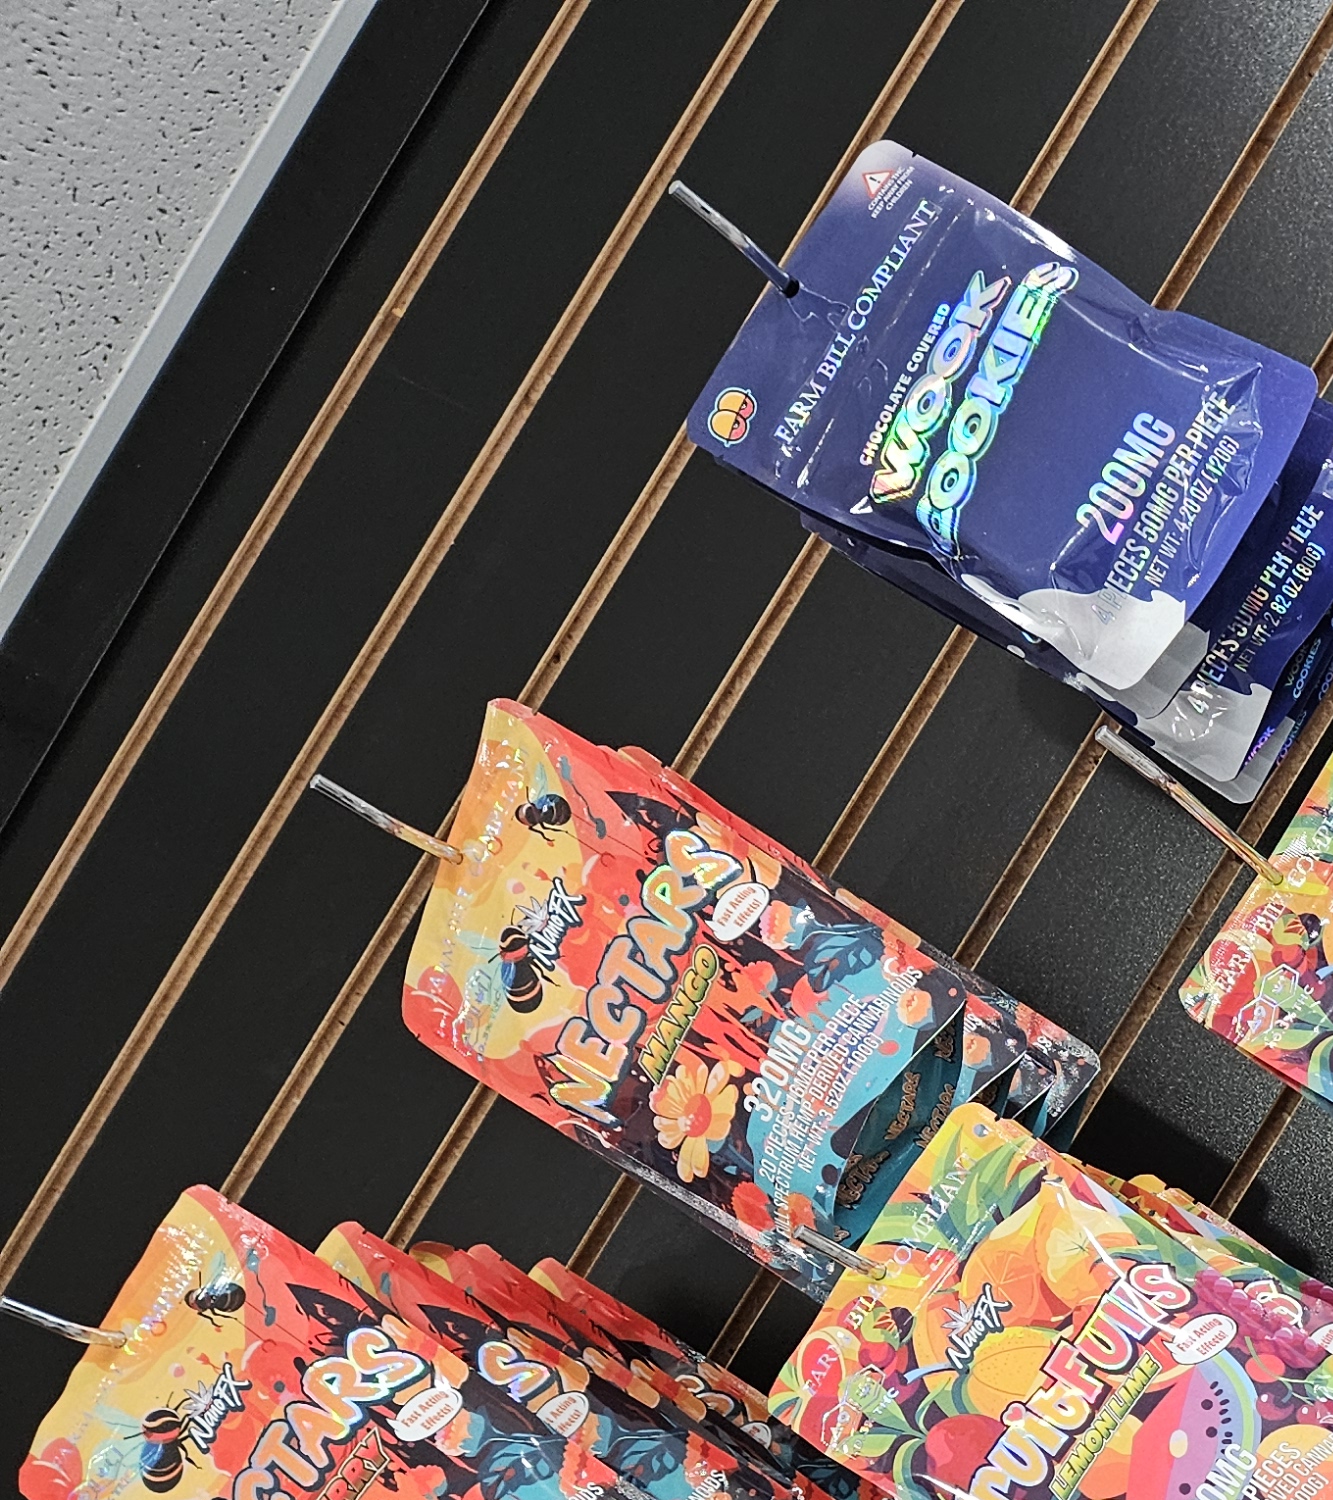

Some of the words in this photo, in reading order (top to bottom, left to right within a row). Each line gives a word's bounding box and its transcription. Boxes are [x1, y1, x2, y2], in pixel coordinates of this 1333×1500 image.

[772, 377, 827, 447] FARM
[814, 326, 858, 381] BILL
[842, 198, 939, 333] COMPLIANT
[856, 371, 913, 468] CHOCOLATE
[904, 300, 953, 374] COVERED
[866, 268, 1012, 495] WOOK
[1072, 407, 1180, 546] 200MG
[1096, 536, 1152, 610] PIECES
[1132, 480, 1183, 544] 50MG
[1163, 440, 1206, 489] PER
[1186, 390, 1236, 451] PIECE
[517, 876, 586, 971] NanoFX
[548, 826, 740, 1126] NECTARS
[632, 941, 729, 1087] MANGO
[738, 1016, 814, 1125] 320MG
[808, 1030, 841, 1067] PER
[826, 992, 866, 1037] PIECE
[764, 1102, 804, 1164] PIECES
[786, 1059, 824, 1109] 16MG
[757, 1157, 782, 1184] 20
[1048, 1411, 1118, 1500] LEMON
[1104, 1351, 1164, 1420] LIME
